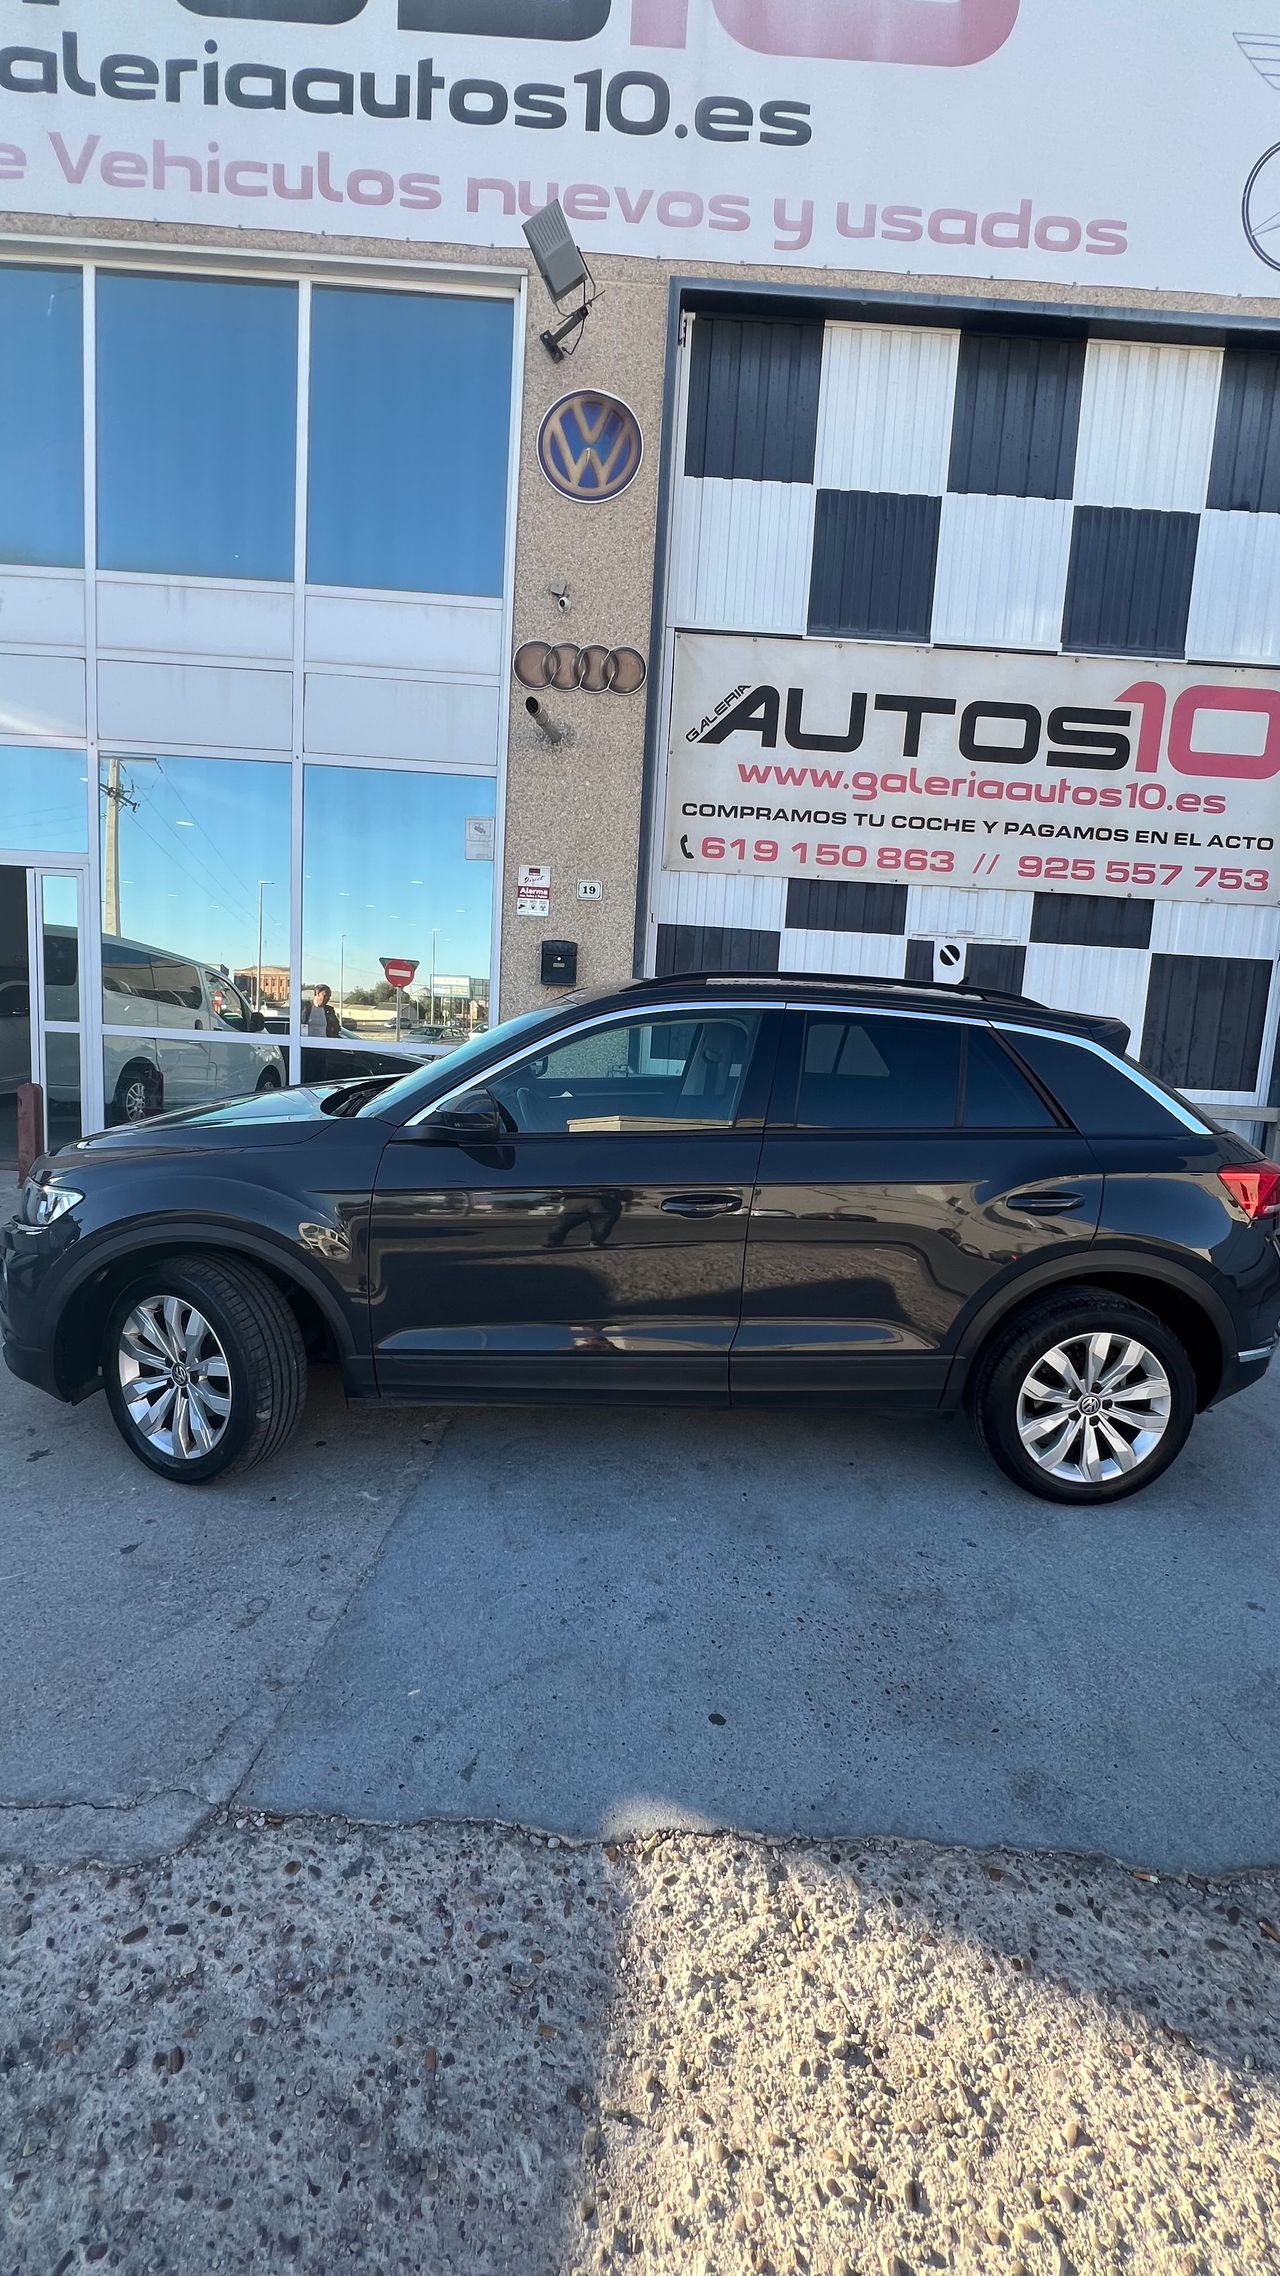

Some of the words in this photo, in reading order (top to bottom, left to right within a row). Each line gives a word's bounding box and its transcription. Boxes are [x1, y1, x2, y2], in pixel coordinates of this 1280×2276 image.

[48, 131, 441, 210] Vehiculos
[466, 177, 750, 231] nuevos
[772, 198, 814, 251] y
[836, 199, 1128, 256] usados
[685, 685, 752, 743] GALERIA
[737, 762, 1227, 815] www.galeriaautos10.es
[681, 803, 847, 825] COMPRAMOS
[853, 813, 886, 828] TU
[891, 815, 976, 833] COCHE
[982, 820, 999, 834] Y
[1004, 822, 1129, 842] PAGAMOS
[1135, 830, 1168, 845] EN
[1174, 832, 1202, 846] EL
[1207, 834, 1274, 851] ACTO
[583, 886, 596, 894] 19
[701, 836, 779, 863] 619
[791, 842, 867, 868] 150
[877, 847, 955, 873] 863
[1017, 855, 1096, 881] 925
[1105, 860, 1183, 886] 557
[1193, 866, 1270, 891] 753
[520, 887, 548, 895] Alarma
